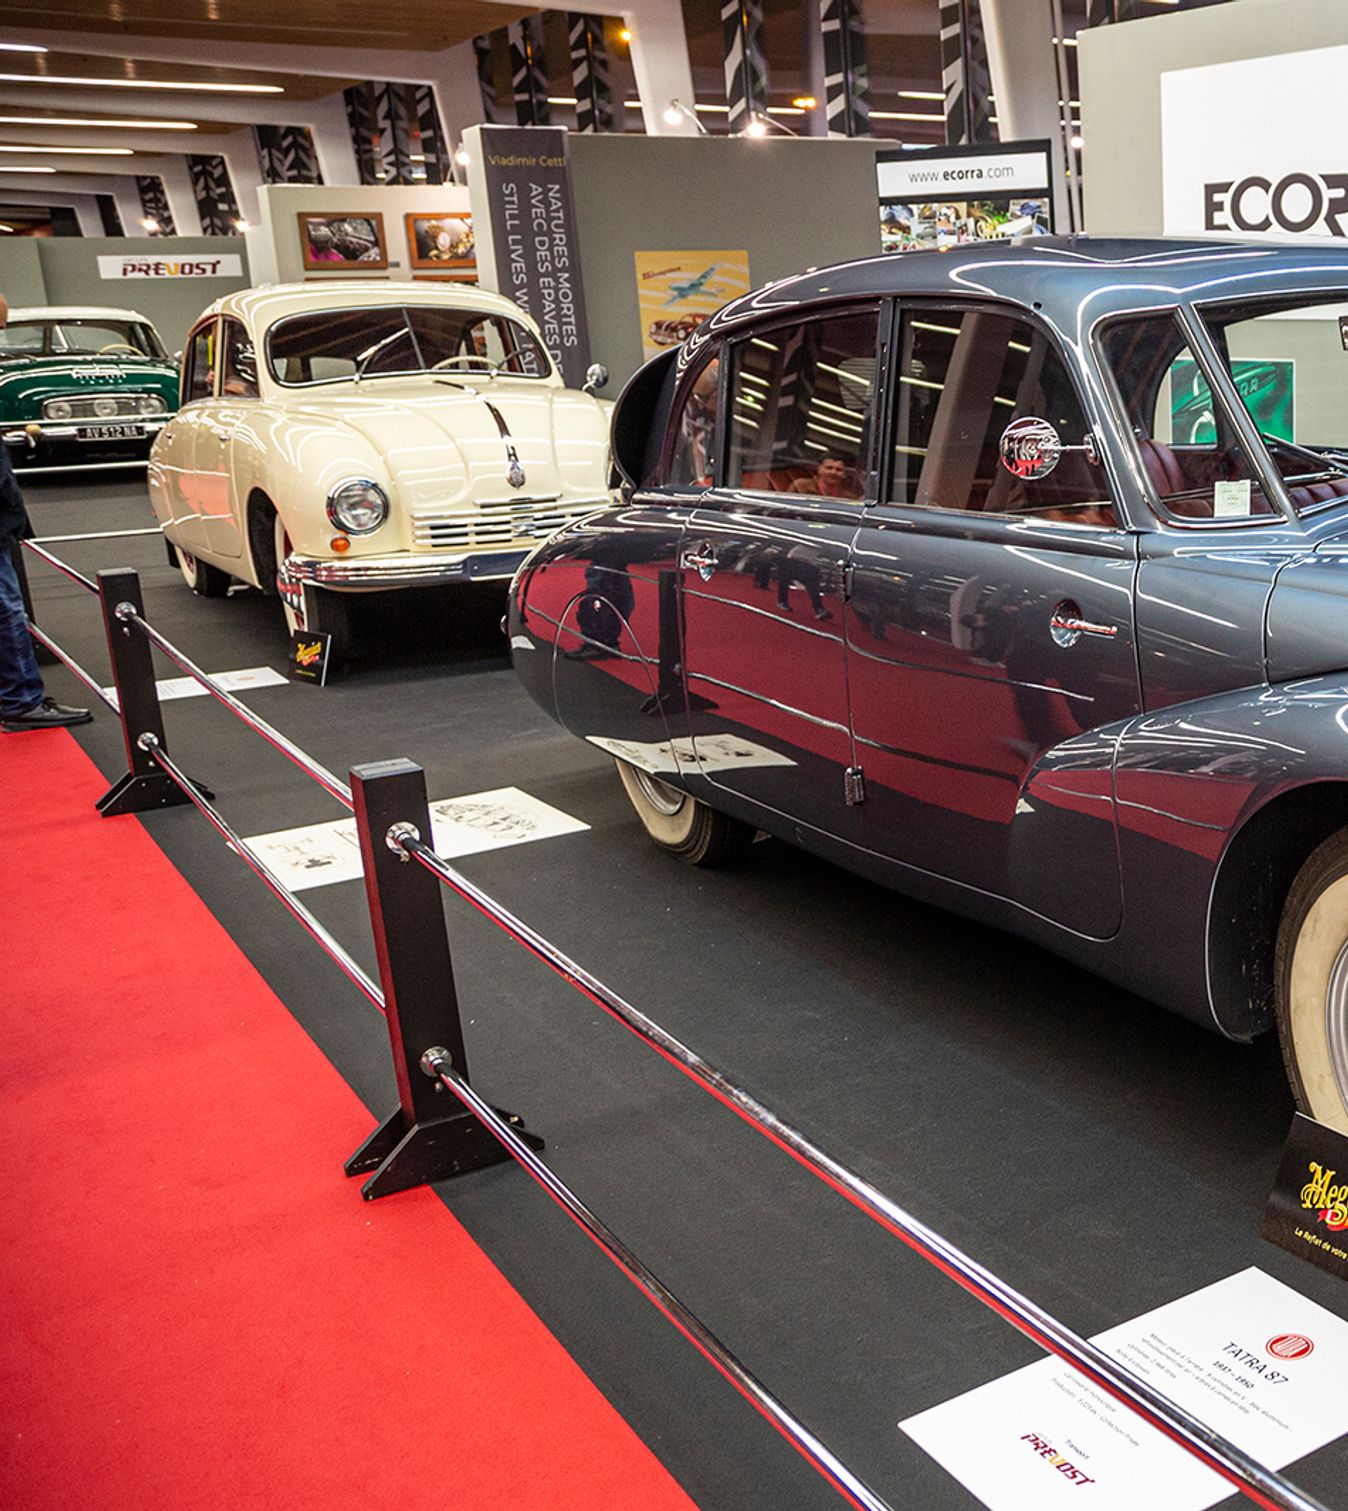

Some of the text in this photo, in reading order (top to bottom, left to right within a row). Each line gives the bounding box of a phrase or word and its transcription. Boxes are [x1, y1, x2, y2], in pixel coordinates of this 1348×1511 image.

[907, 164, 1015, 183] www.ecorra.com
[502, 182, 520, 231] STILL
[528, 182, 548, 232] AVEC
[508, 235, 528, 285] LIVES
[534, 236, 552, 273] DES
[547, 184, 578, 347] NATURES MORTES
[1222, 1341, 1268, 1374] TATRA
[1264, 1370, 1290, 1385] 87
